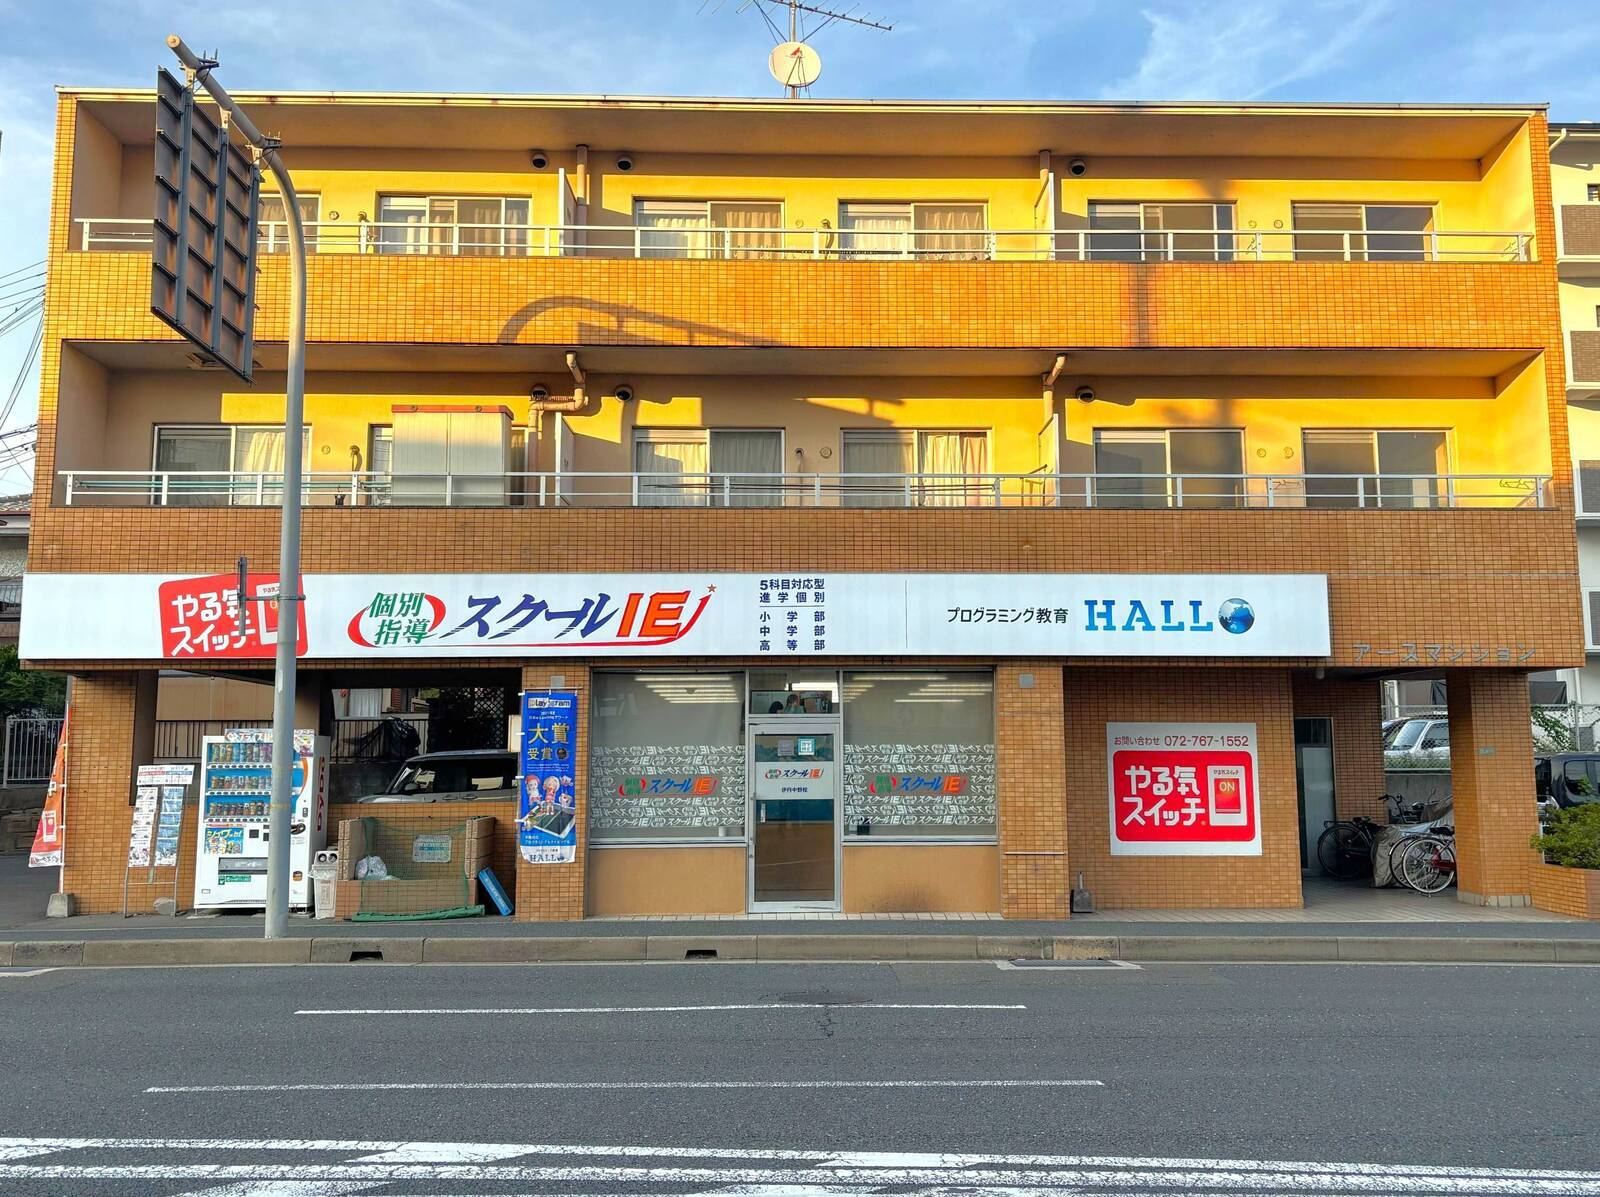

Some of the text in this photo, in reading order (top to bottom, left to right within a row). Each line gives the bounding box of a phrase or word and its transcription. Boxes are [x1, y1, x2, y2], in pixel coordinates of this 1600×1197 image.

[760, 578, 825, 590] 5科目対応型
[369, 592, 426, 618] 個別
[760, 592, 825, 603] 進学個別
[760, 611, 825, 622] 小学部
[947, 607, 1069, 624] プログラミング教育
[170, 620, 256, 657] スイッチ
[374, 618, 431, 645] 指導
[760, 626, 825, 637] 中学部
[760, 640, 825, 651] 高等部
[1353, 642, 1537, 663] アースマンション
[527, 722, 570, 744] 大賞
[1114, 735, 1249, 747] お問い合わせ 072-767-1552
[527, 747, 553, 760] 受賞
[647, 777, 713, 794] スクールIE
[898, 776, 961, 794] スクールIE
[1124, 765, 1201, 796] やる気
[1219, 782, 1236, 792] ON
[1122, 797, 1206, 827] スイッチ
